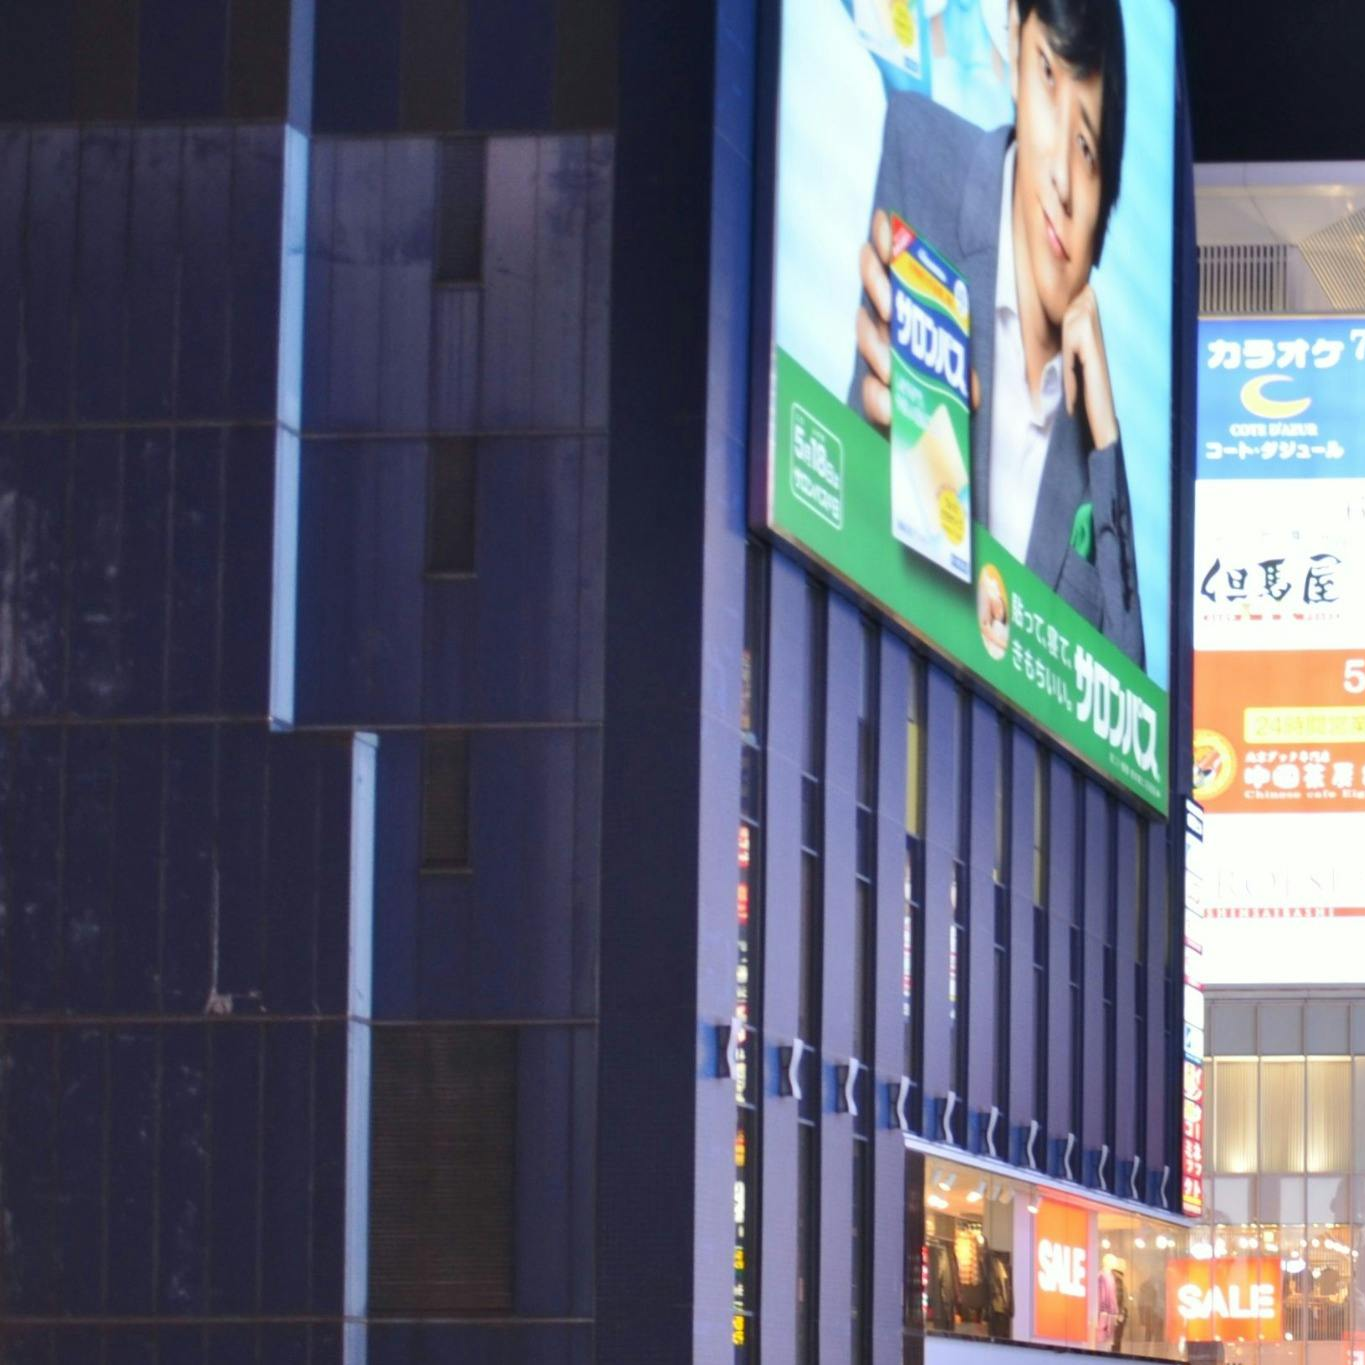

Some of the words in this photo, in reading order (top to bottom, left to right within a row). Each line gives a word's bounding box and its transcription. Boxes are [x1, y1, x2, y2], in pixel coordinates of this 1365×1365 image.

[895, 289, 969, 398] サロンパス
[1207, 338, 1344, 369] カラオケ
[1075, 644, 1160, 784] サロンパス
[1038, 1239, 1086, 1297] SALE
[1177, 1283, 1276, 1319] SALE
